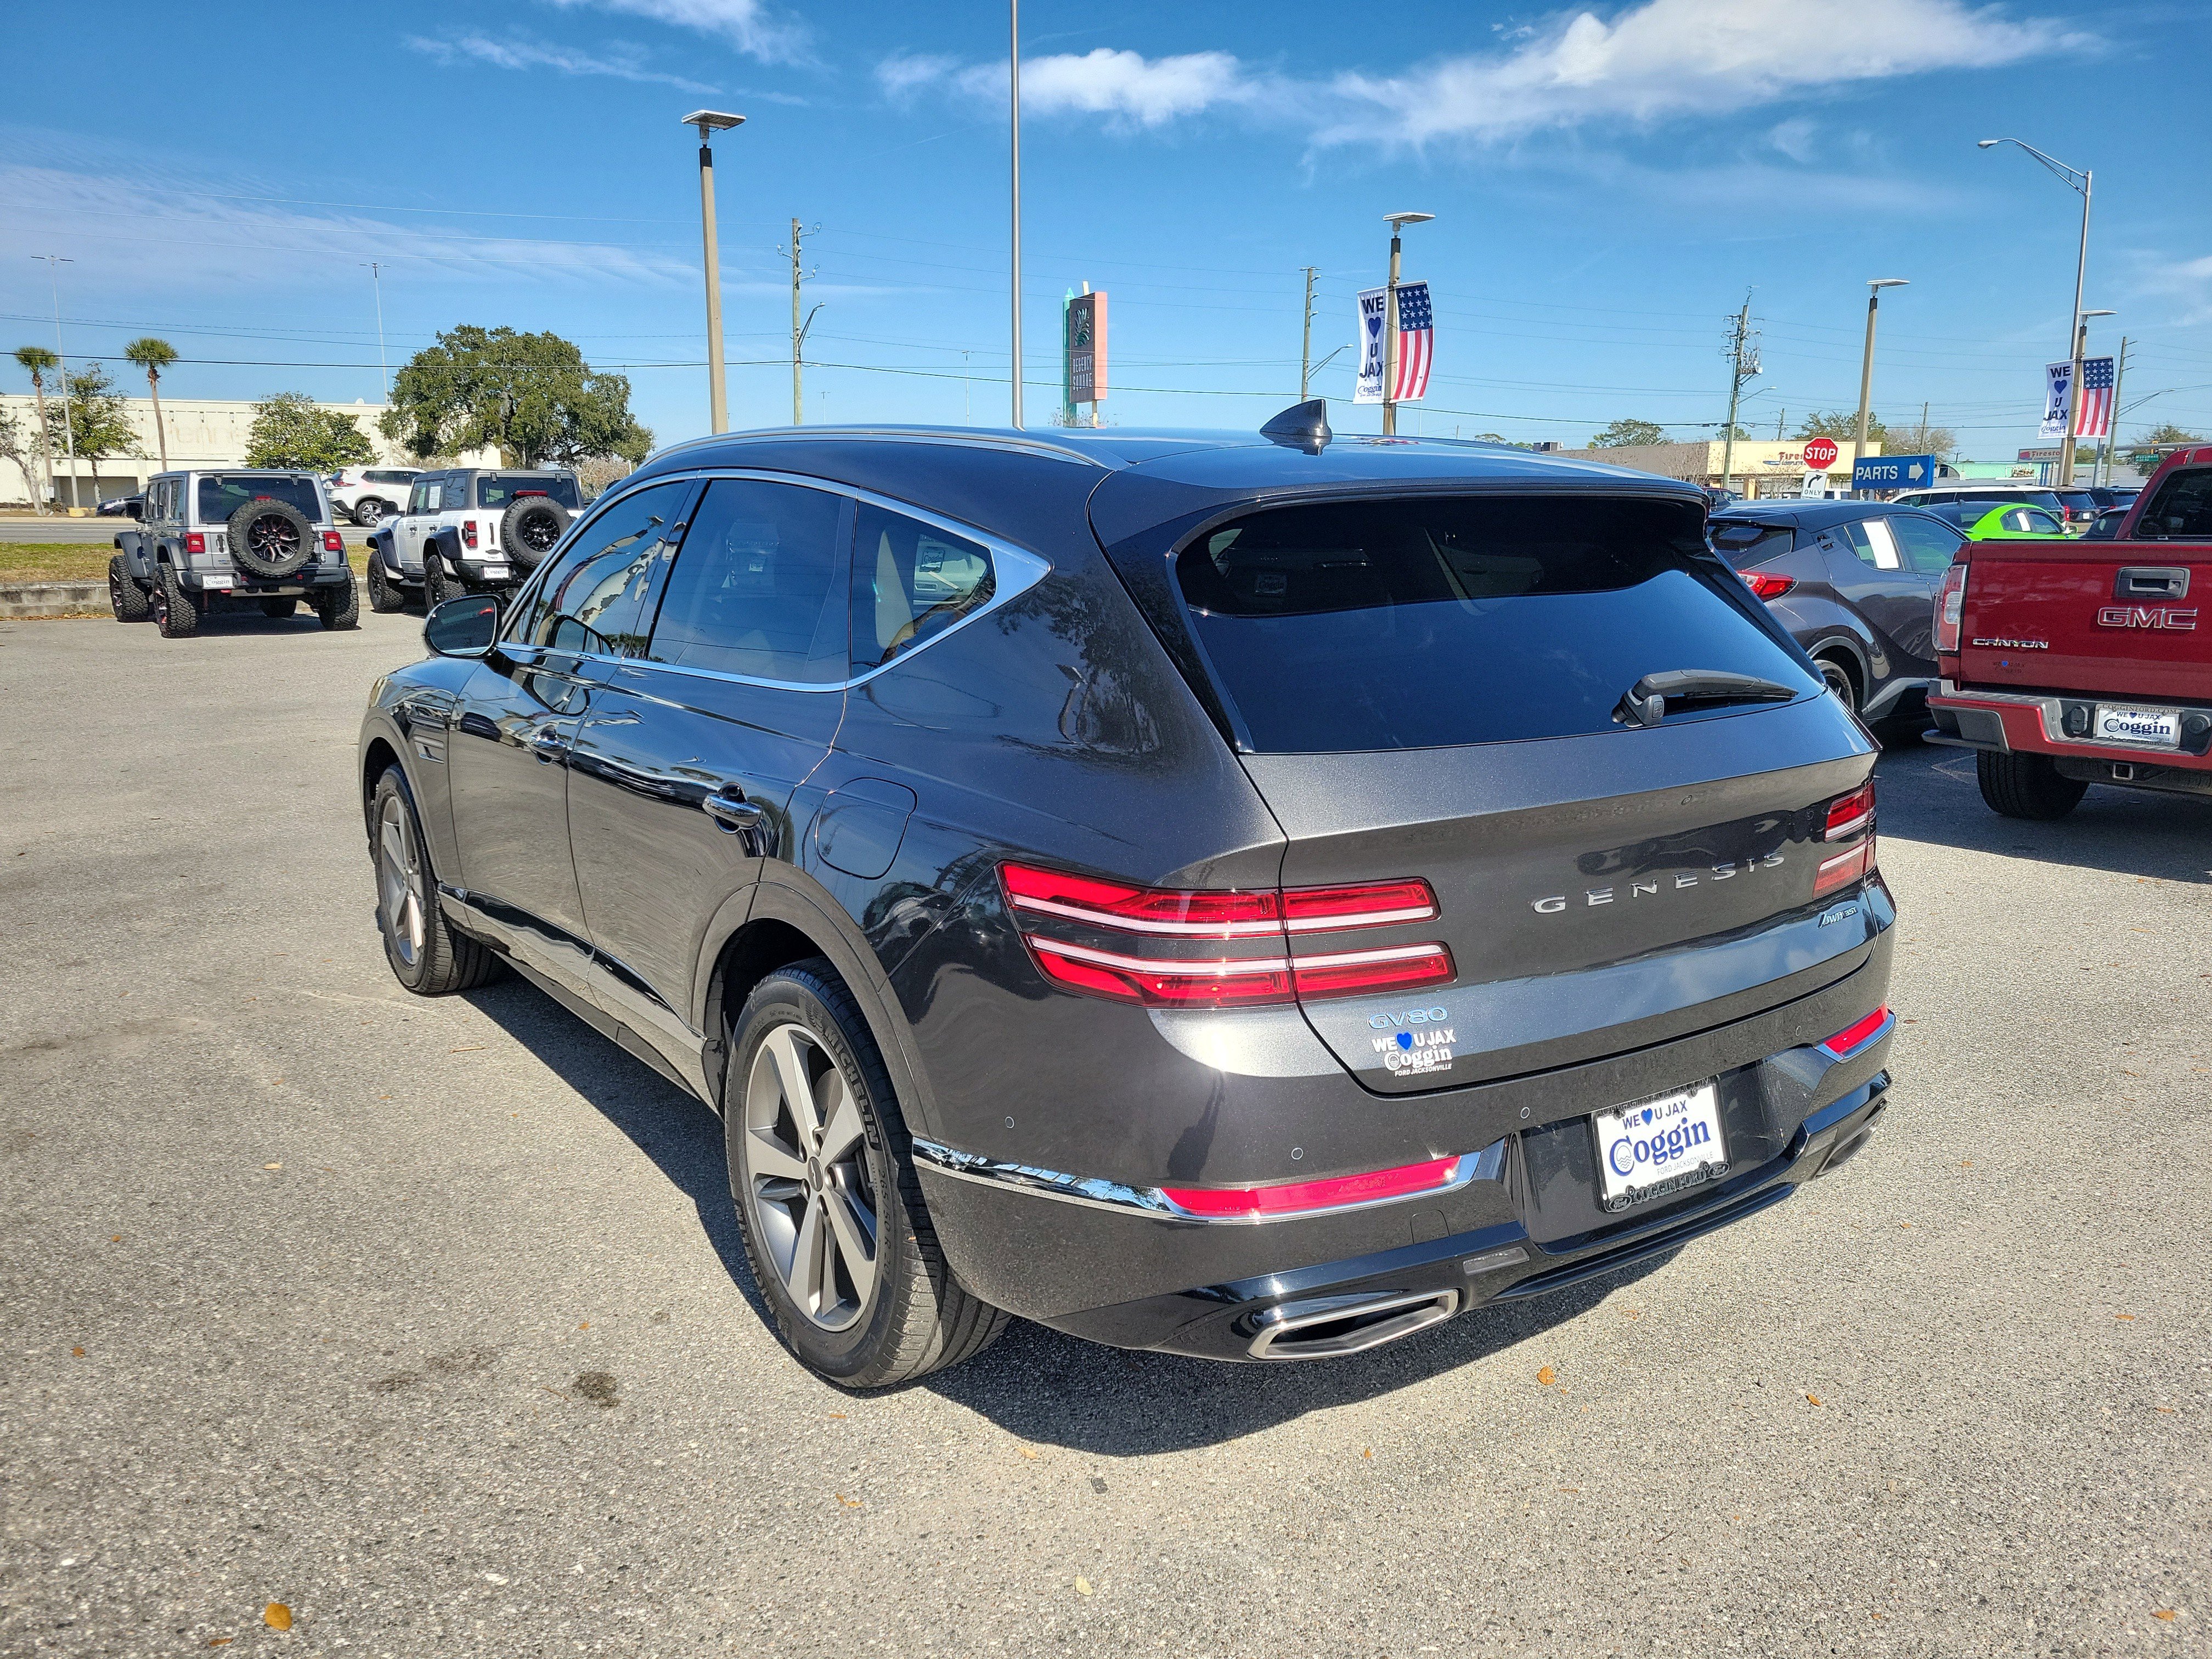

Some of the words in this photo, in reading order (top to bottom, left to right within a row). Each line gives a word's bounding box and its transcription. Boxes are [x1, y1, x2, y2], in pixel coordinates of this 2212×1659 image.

[1361, 296, 1384, 314] WE
[1370, 342, 1378, 358] U
[1073, 355, 1092, 374] REGENCY
[1359, 361, 1384, 379] JAX
[2050, 366, 2071, 378] WE
[1073, 373, 1092, 392] SQUARE
[2055, 397, 2062, 408] U
[2043, 409, 2068, 421] JAX
[2041, 424, 2066, 432] Coggin
[1805, 447, 1836, 461] STOP
[1855, 466, 1898, 481] PARTS
[2097, 607, 2198, 630] GMC
[1972, 638, 2049, 649] CANYON
[2102, 704, 2177, 714] COGGINFORD.COM
[2103, 718, 2171, 736] Coggin
[1533, 850, 1785, 913] GENESIS
[1367, 1006, 1448, 1029] GV80
[1372, 1036, 1398, 1053] WE
[1413, 1032, 1426, 1047] U
[1426, 1029, 1457, 1046] JAX
[1384, 1045, 1453, 1071] Coggin
[1410, 1063, 1452, 1075] JACKSONVILLE
[824, 1025, 879, 1144] MICHELIN
[1622, 1114, 1640, 1130] WE
[1655, 1107, 1663, 1120] U
[1665, 1100, 1688, 1116] JAX
[1609, 1117, 1711, 1177] Coggin
[1657, 1164, 1672, 1176] FORD
[1673, 1151, 1713, 1173] JACKSONVILLE
[1634, 1179, 1677, 1203] COGGIN
[1678, 1169, 1707, 1190] FORD
